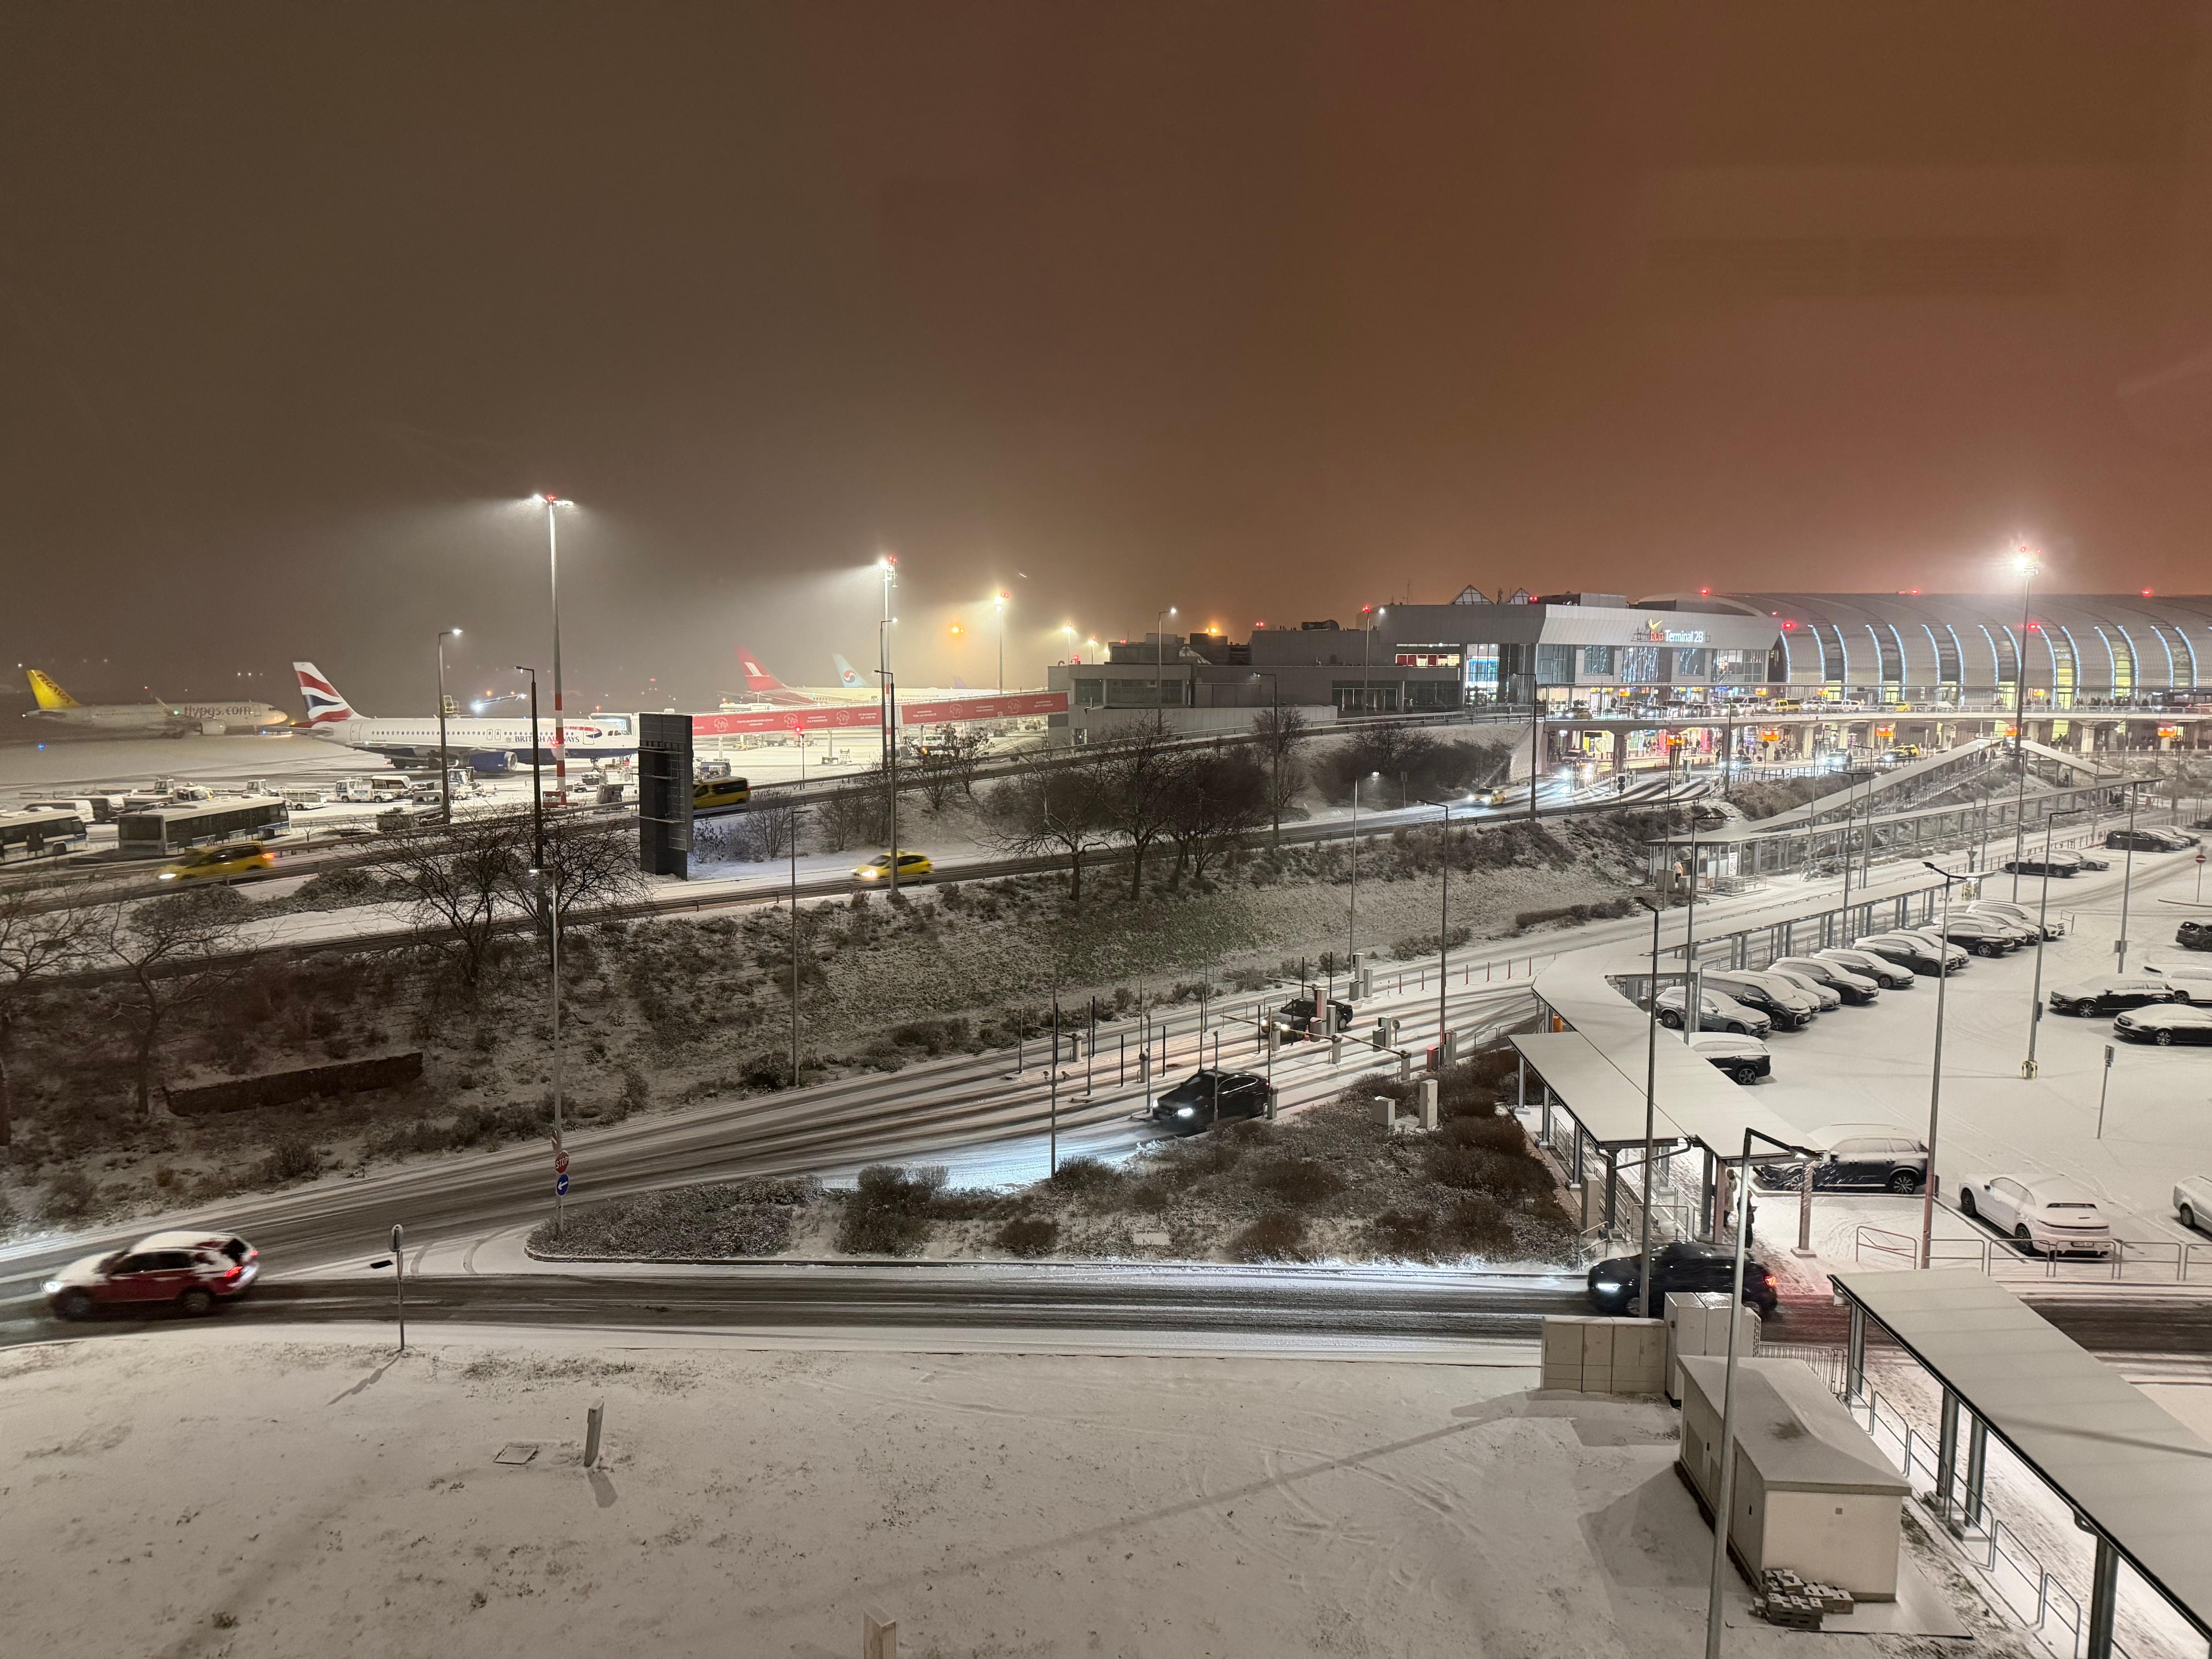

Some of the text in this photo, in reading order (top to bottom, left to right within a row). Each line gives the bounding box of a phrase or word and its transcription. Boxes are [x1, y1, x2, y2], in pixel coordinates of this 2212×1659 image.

[1665, 630, 1694, 642] Terminal
[1694, 630, 1704, 643] 2B
[184, 705, 251, 718] flypgs.com
[556, 1156, 568, 1169] STOP
